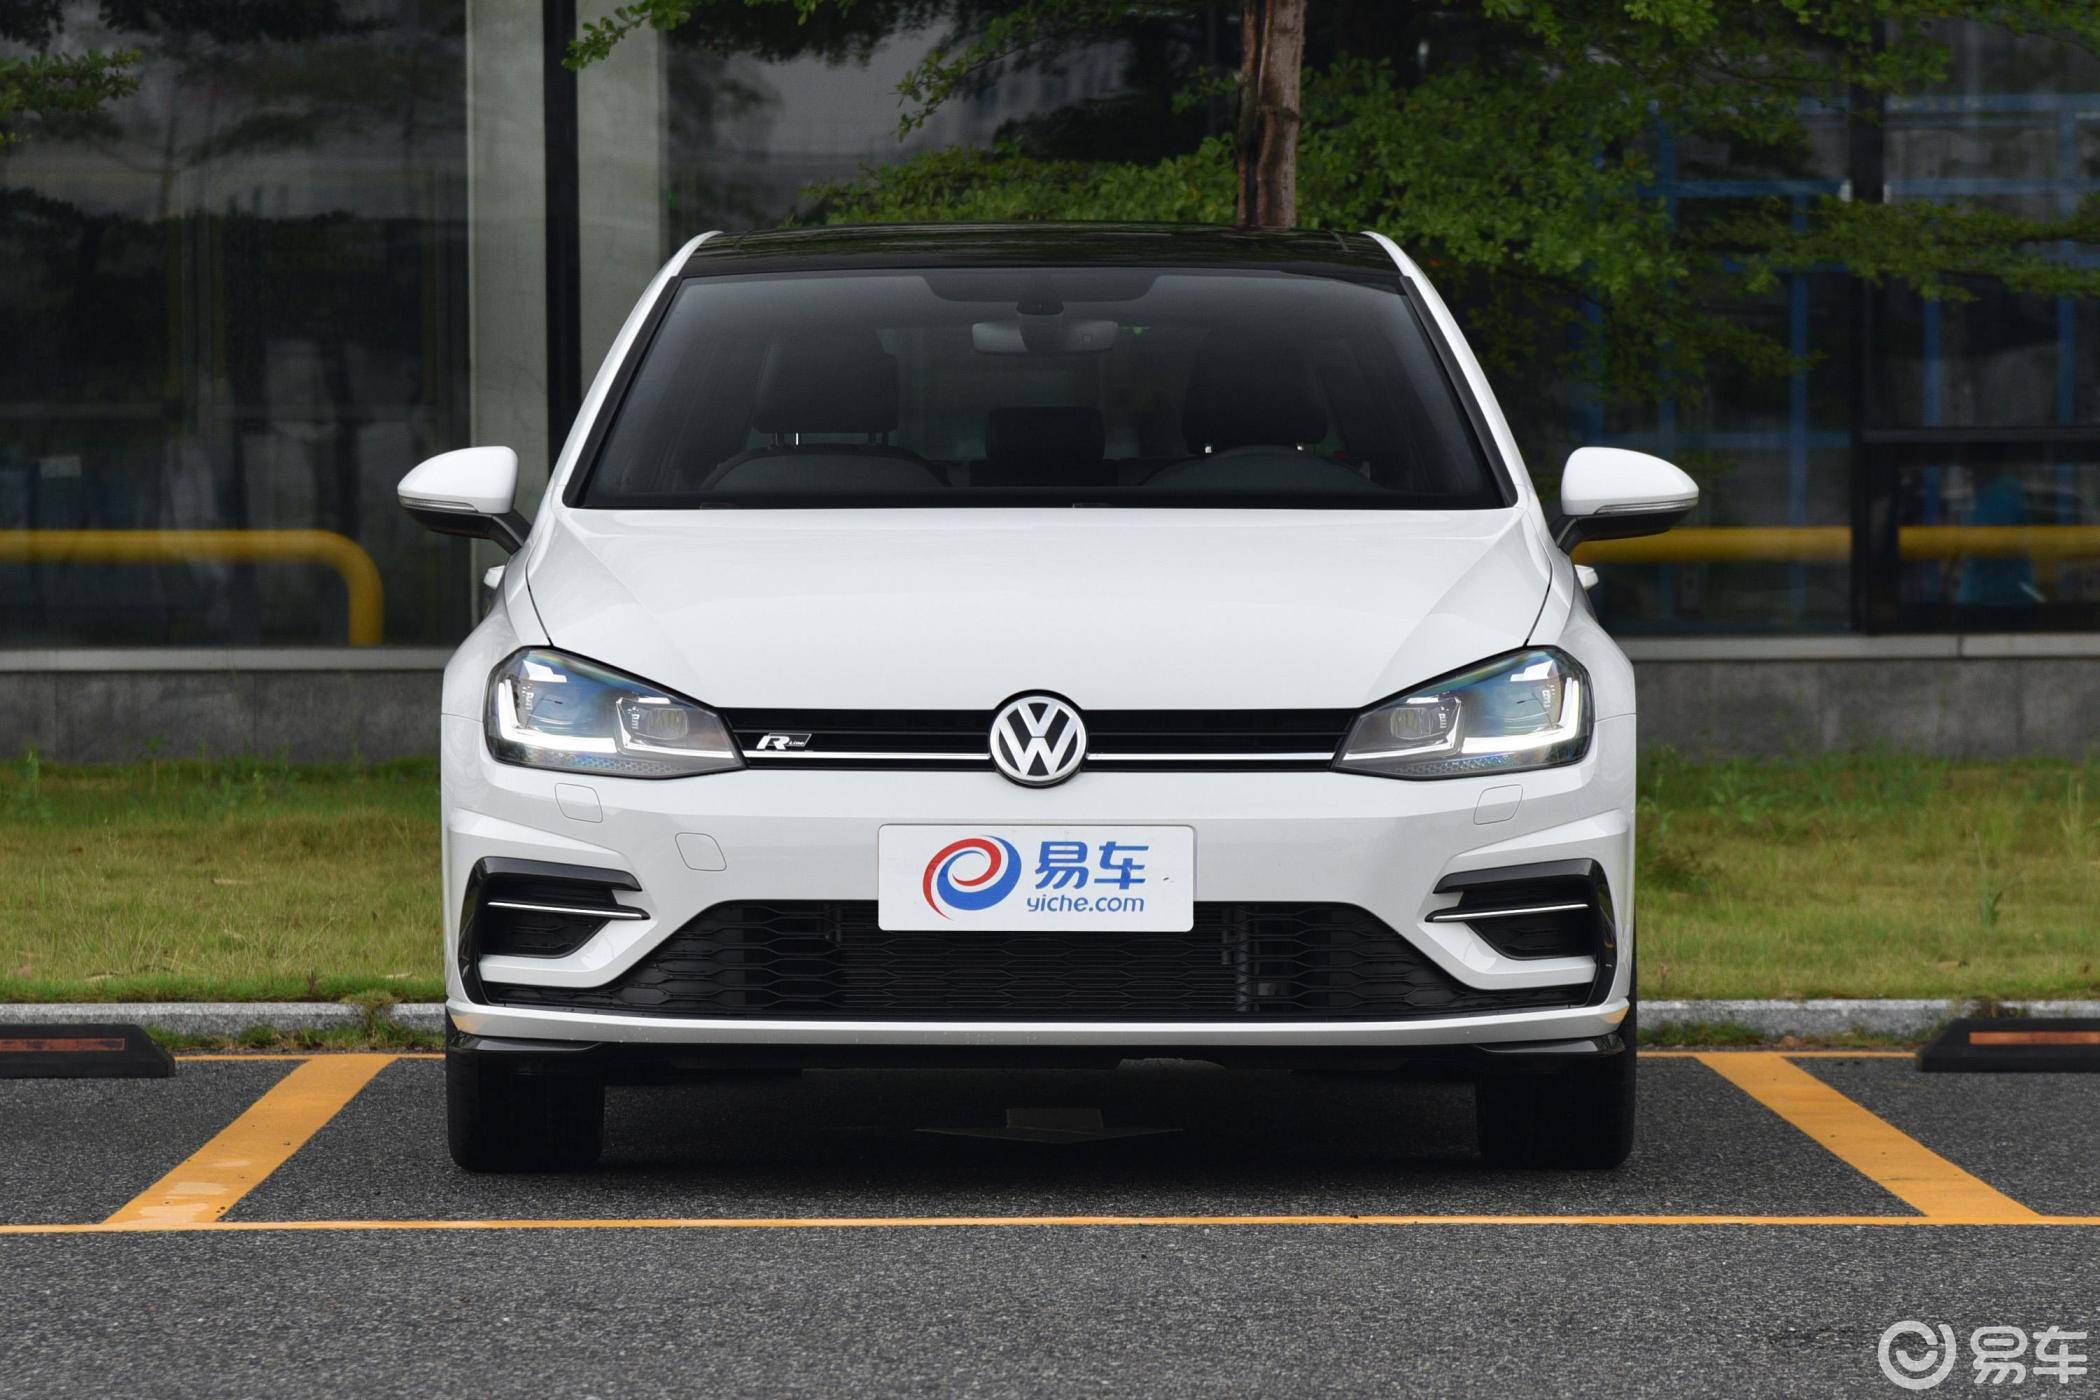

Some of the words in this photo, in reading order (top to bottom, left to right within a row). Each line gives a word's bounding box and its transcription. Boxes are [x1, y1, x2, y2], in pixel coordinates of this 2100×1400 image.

[756, 735, 790, 750] R
[1034, 841, 1149, 890] 易车
[1026, 894, 1145, 912] yiche.com
